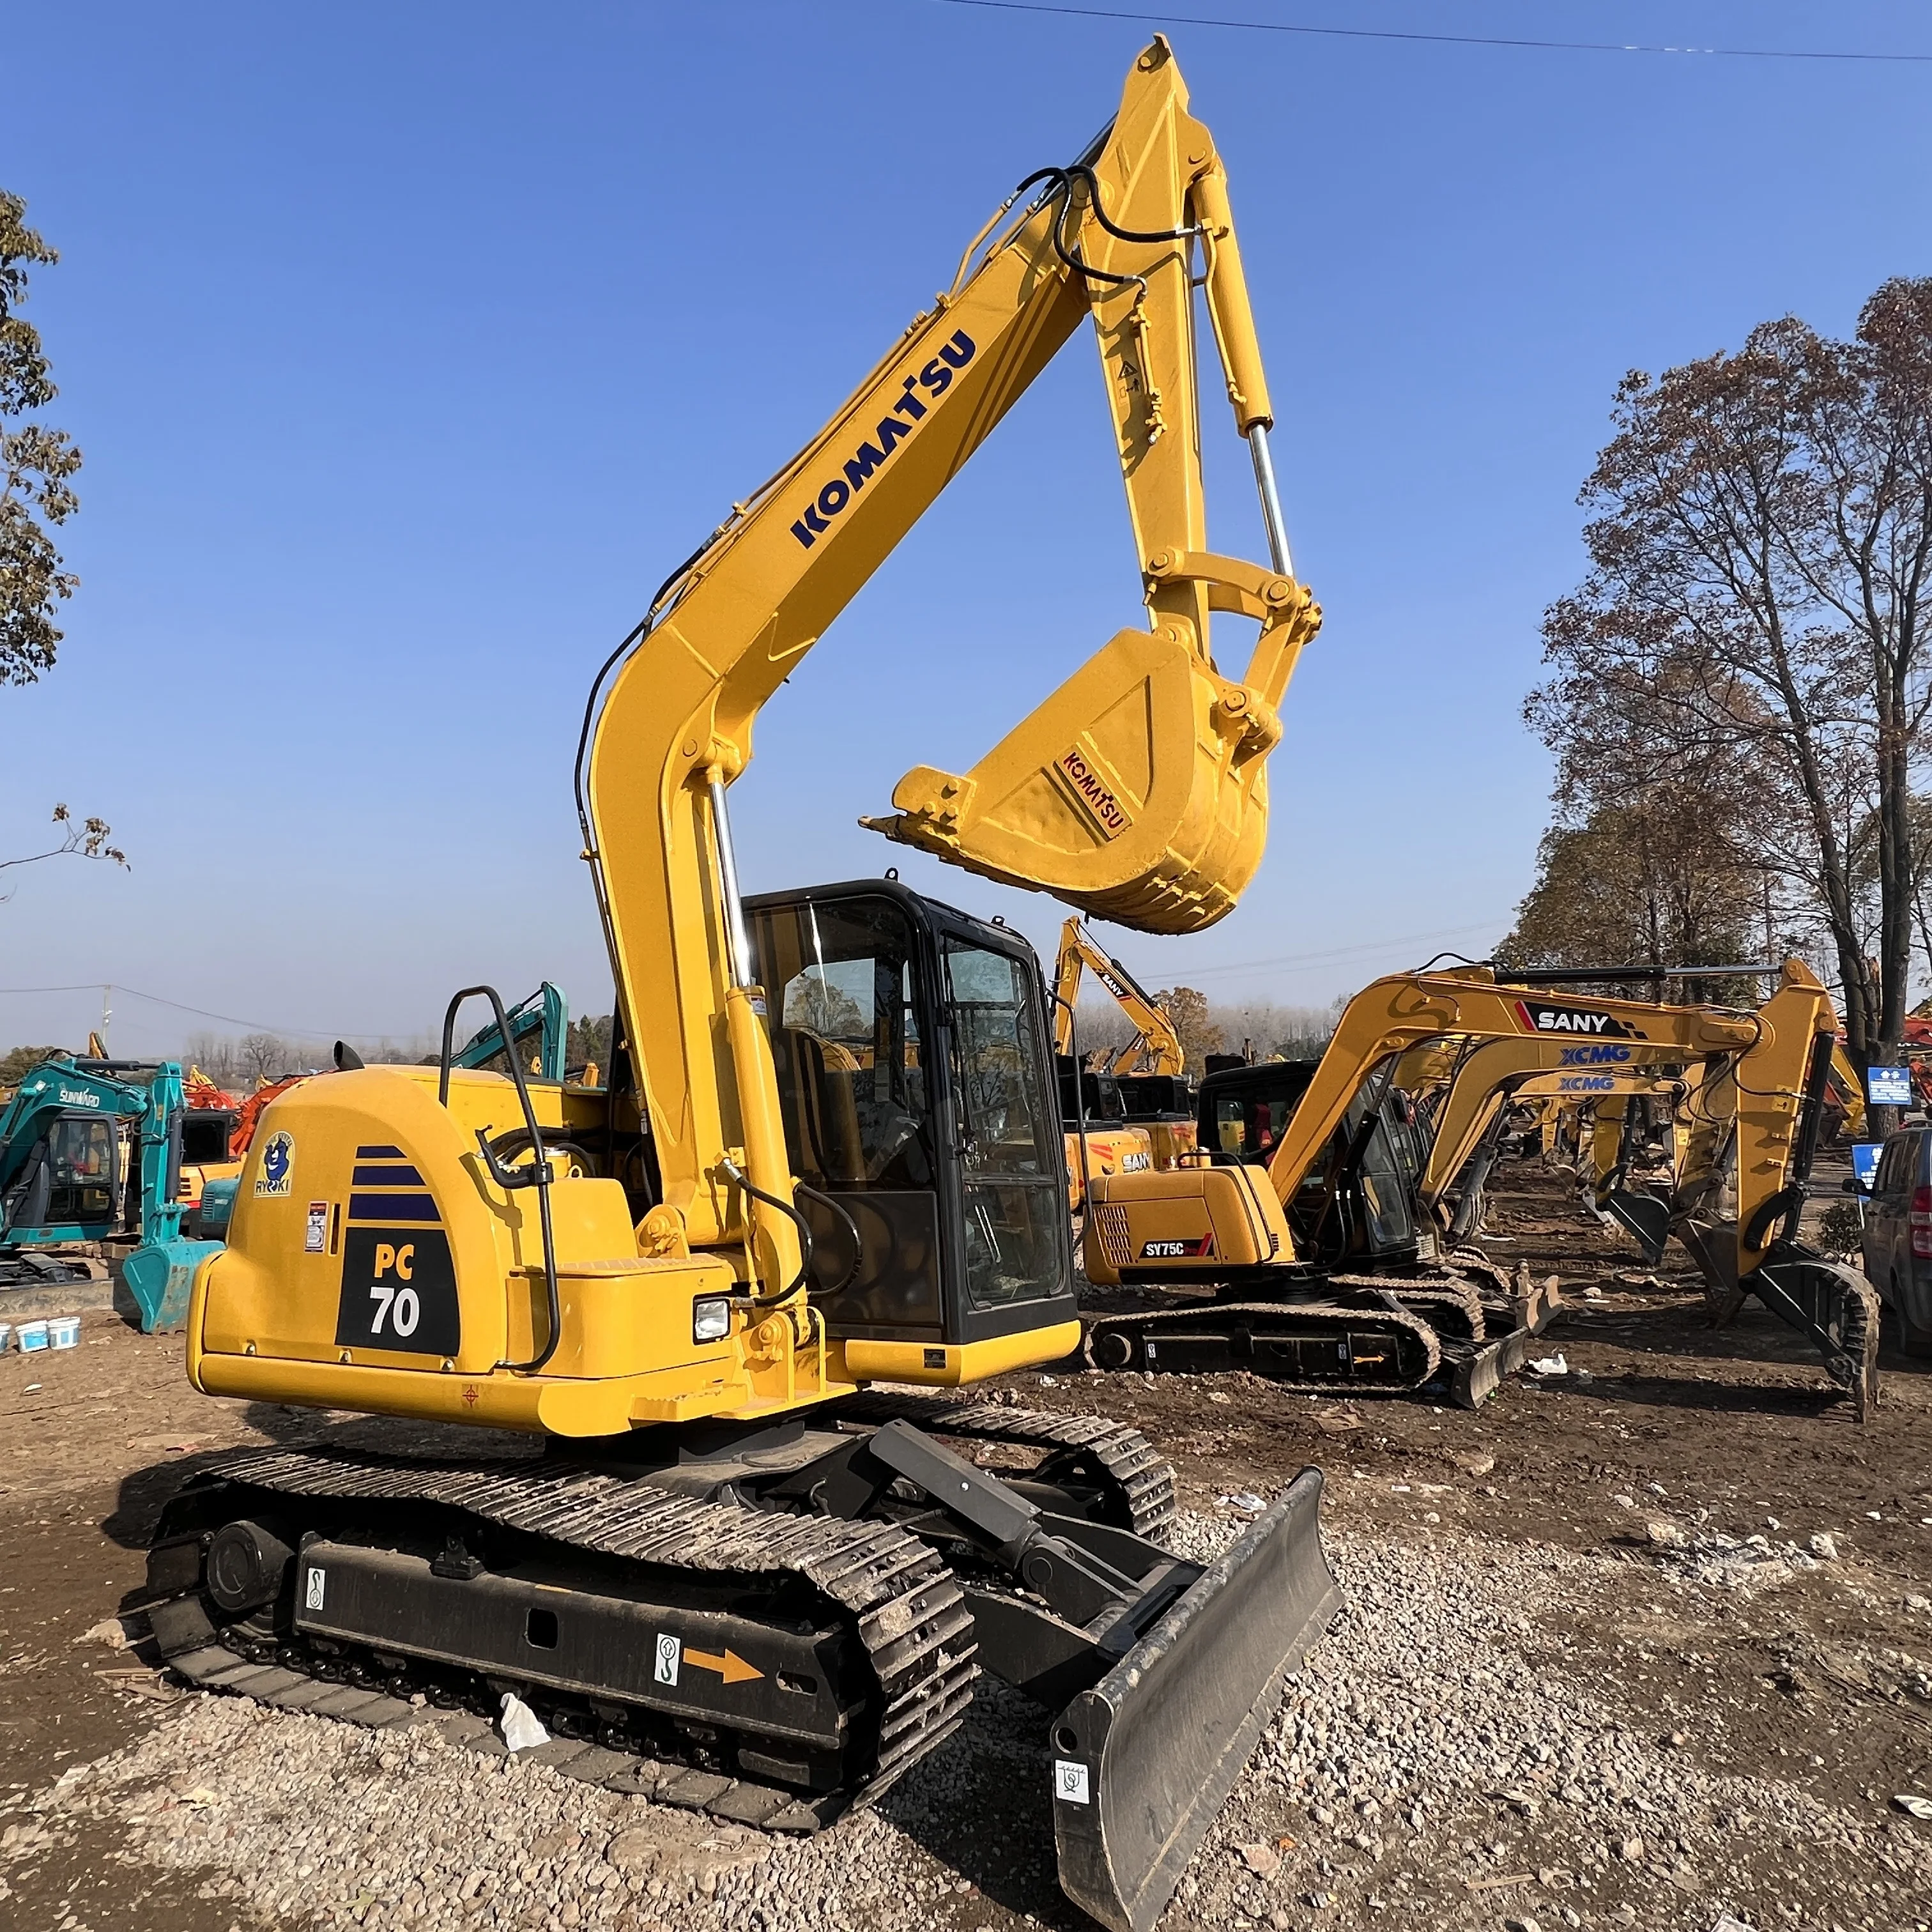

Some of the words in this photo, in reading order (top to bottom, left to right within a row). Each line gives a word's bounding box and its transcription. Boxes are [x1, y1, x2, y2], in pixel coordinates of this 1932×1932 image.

[790, 328, 976, 550] KOMATSU
[1062, 751, 1124, 829] KOMATSU
[1101, 974, 1124, 996] SANY
[1538, 1012, 1609, 1032] SANY
[1557, 1045, 1630, 1066] XCMG
[1557, 1077, 1614, 1091] XCMG
[59, 1087, 100, 1108] SUNWARD
[1146, 1243, 1184, 1255] SY75C
[374, 1243, 415, 1280] PC
[369, 1286, 420, 1337] 70
